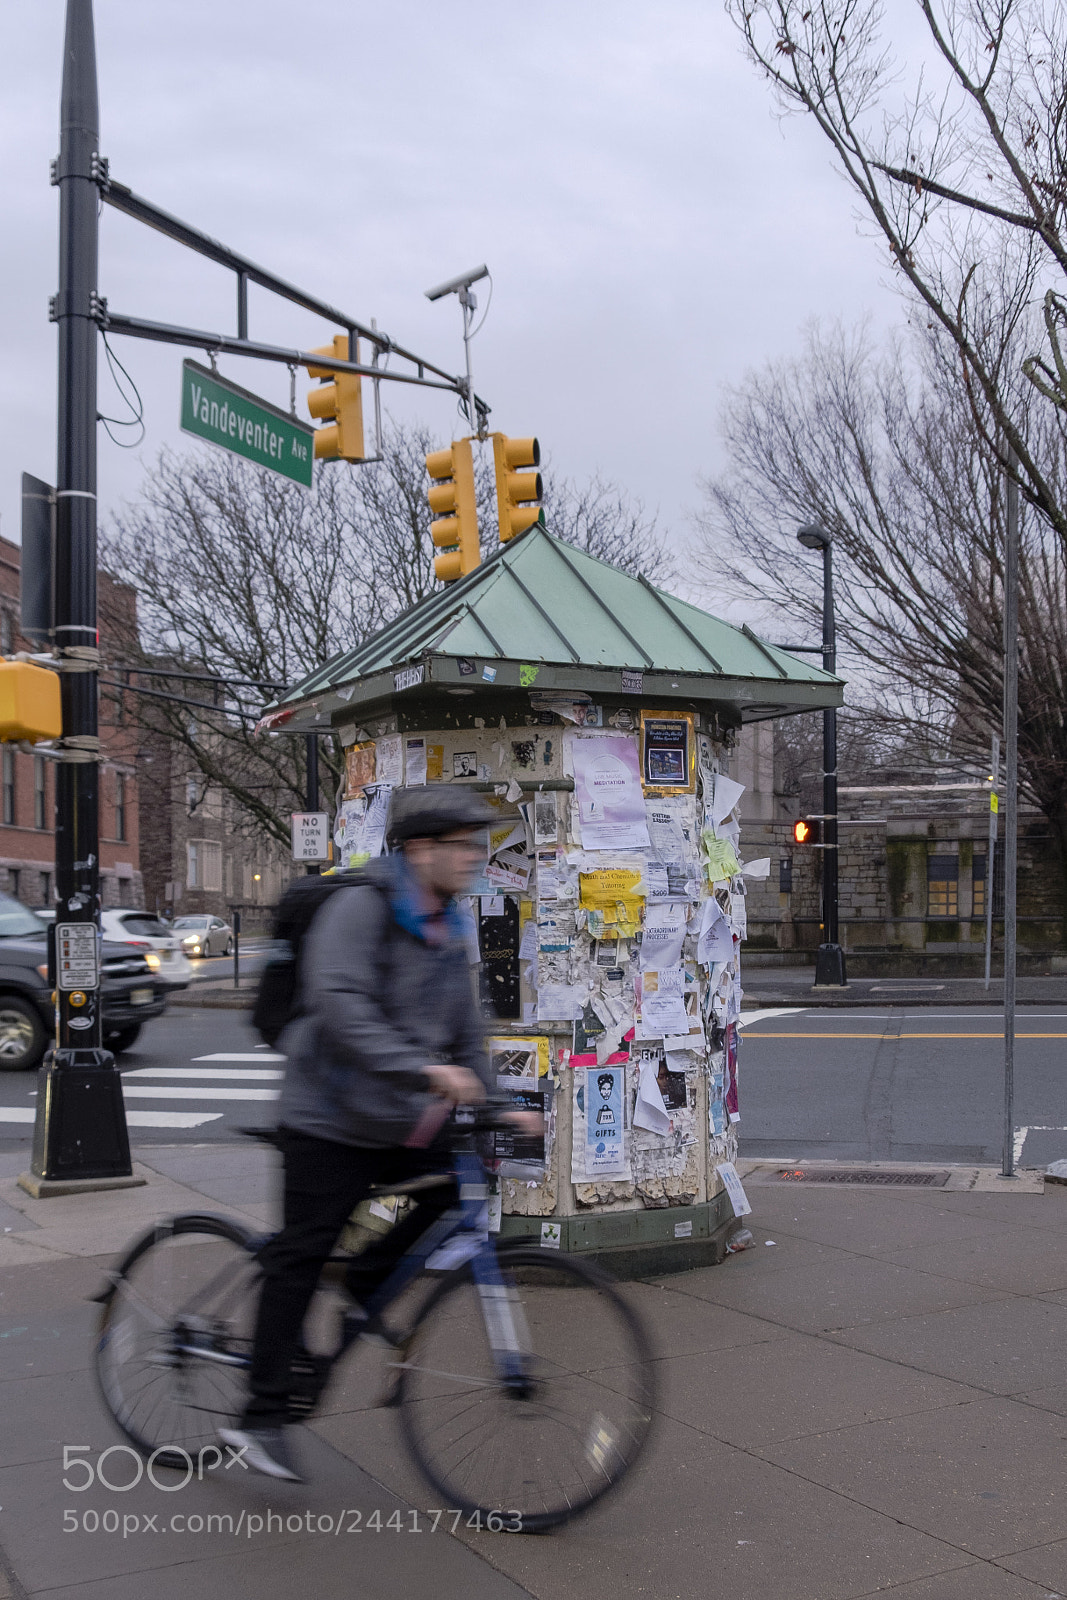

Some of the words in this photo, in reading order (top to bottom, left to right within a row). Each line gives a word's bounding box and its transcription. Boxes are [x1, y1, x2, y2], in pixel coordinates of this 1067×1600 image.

[190, 383, 285, 460] Vandeventer
[291, 437, 308, 462] Ave
[302, 817, 318, 827] NO
[301, 828, 321, 837] TURN
[305, 838, 316, 846] ON
[302, 848, 319, 856] RED
[595, 1129, 616, 1138] GIFTS
